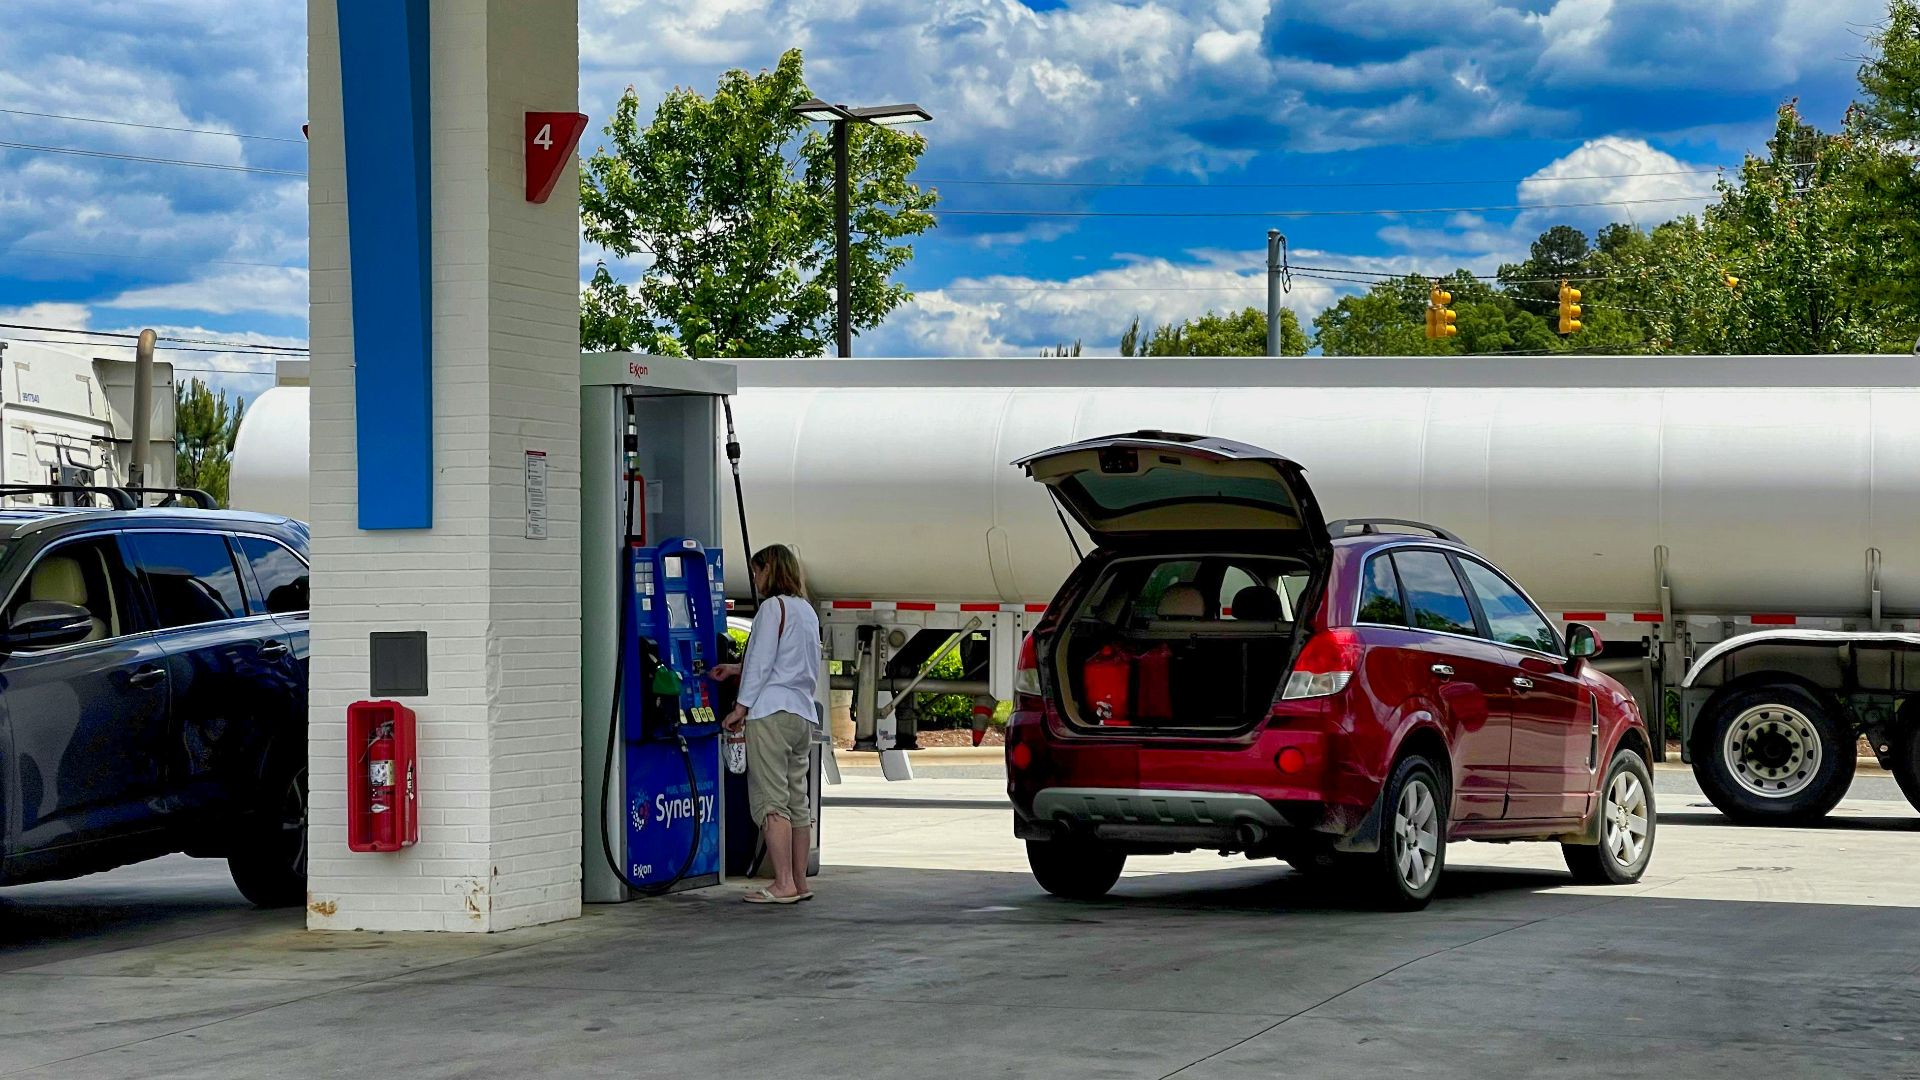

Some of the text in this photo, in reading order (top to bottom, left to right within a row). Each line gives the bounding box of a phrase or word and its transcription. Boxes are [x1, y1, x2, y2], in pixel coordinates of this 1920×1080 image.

[533, 123, 553, 151] 4
[629, 362, 649, 379] Exxon
[715, 555, 722, 569] 4
[633, 863, 652, 879] Exxon
